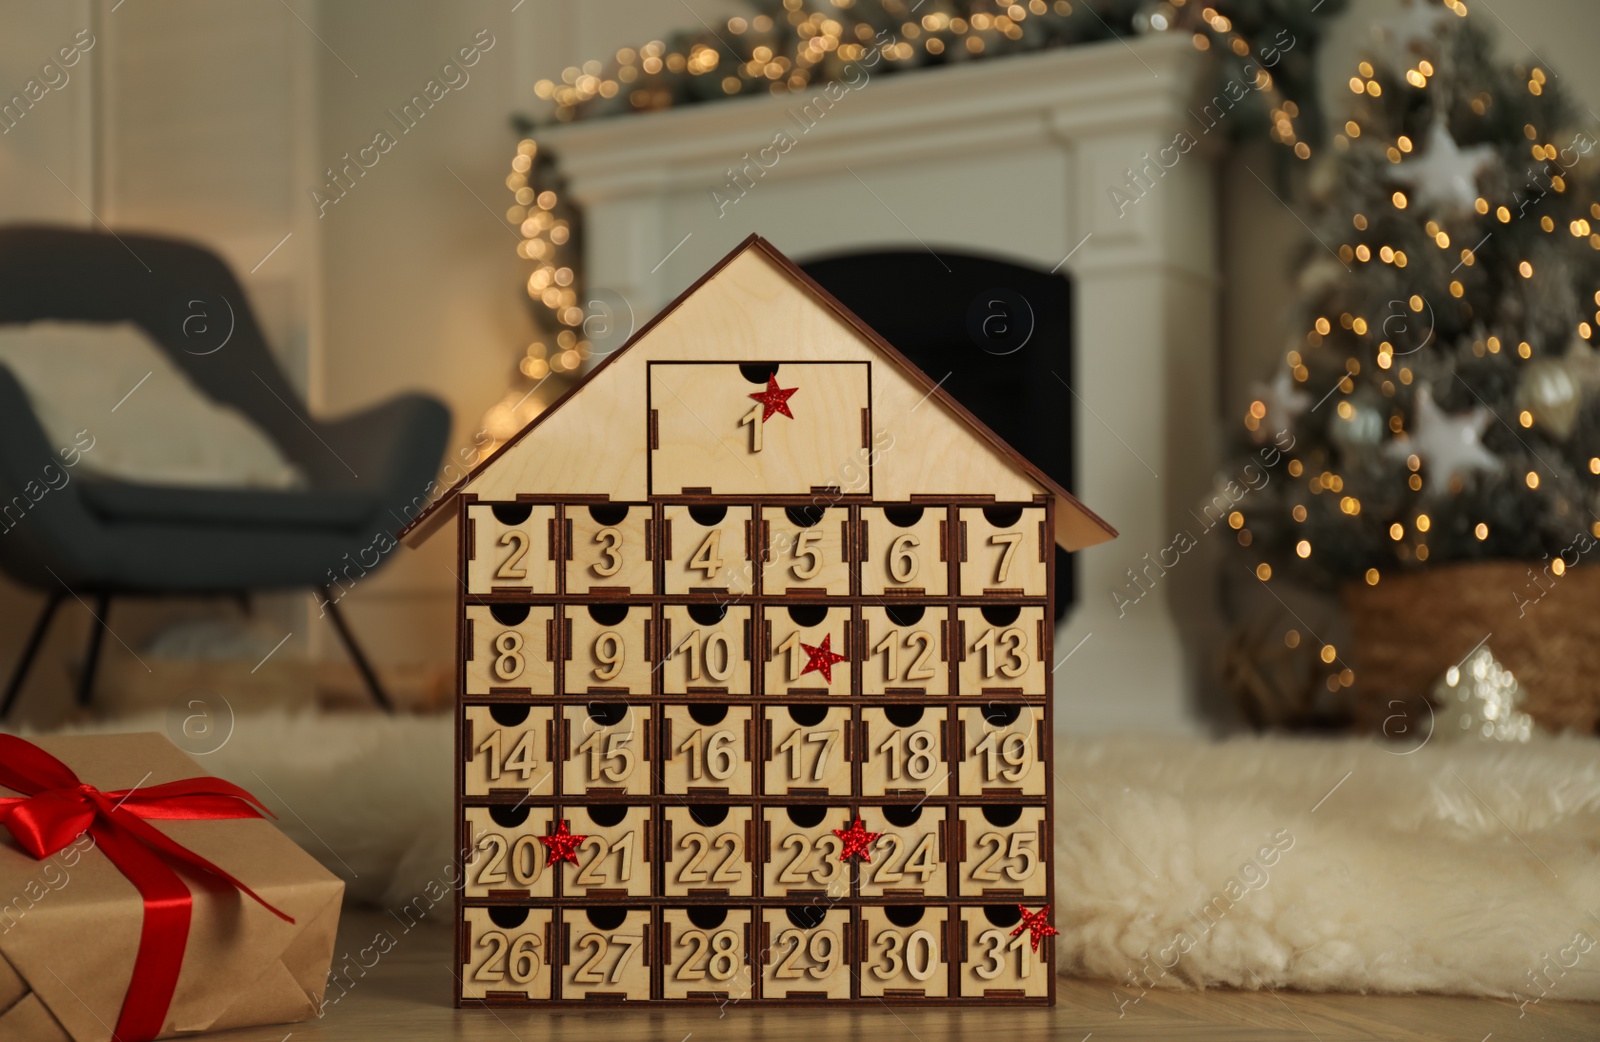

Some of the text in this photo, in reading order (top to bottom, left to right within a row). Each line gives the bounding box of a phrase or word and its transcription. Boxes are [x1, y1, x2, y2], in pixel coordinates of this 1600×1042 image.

[740, 401, 764, 453] 1
[497, 530, 530, 579] 2
[592, 527, 623, 577] 3
[689, 529, 723, 578] 4
[792, 530, 823, 579] 5
[890, 534, 920, 583] 6
[990, 532, 1023, 582] 7
[495, 630, 525, 680] 8
[594, 631, 625, 680] 9
[679, 630, 736, 681] 10
[876, 630, 936, 680] 12
[974, 627, 1030, 678] 13
[480, 729, 537, 780] 14
[580, 730, 634, 782] 15
[680, 729, 737, 780] 16
[780, 729, 839, 780] 17
[881, 730, 937, 780] 18
[975, 730, 1033, 782] 19
[477, 833, 544, 885] 20
[576, 830, 634, 885] 21
[678, 832, 743, 883] 22
[779, 833, 844, 884] 23
[873, 832, 937, 882] 24
[971, 831, 1036, 881] 25
[474, 930, 542, 983] 26
[574, 933, 643, 983] 27
[676, 930, 739, 980] 28
[775, 928, 839, 979] 29
[872, 930, 937, 980] 30
[975, 928, 1032, 979] 31
